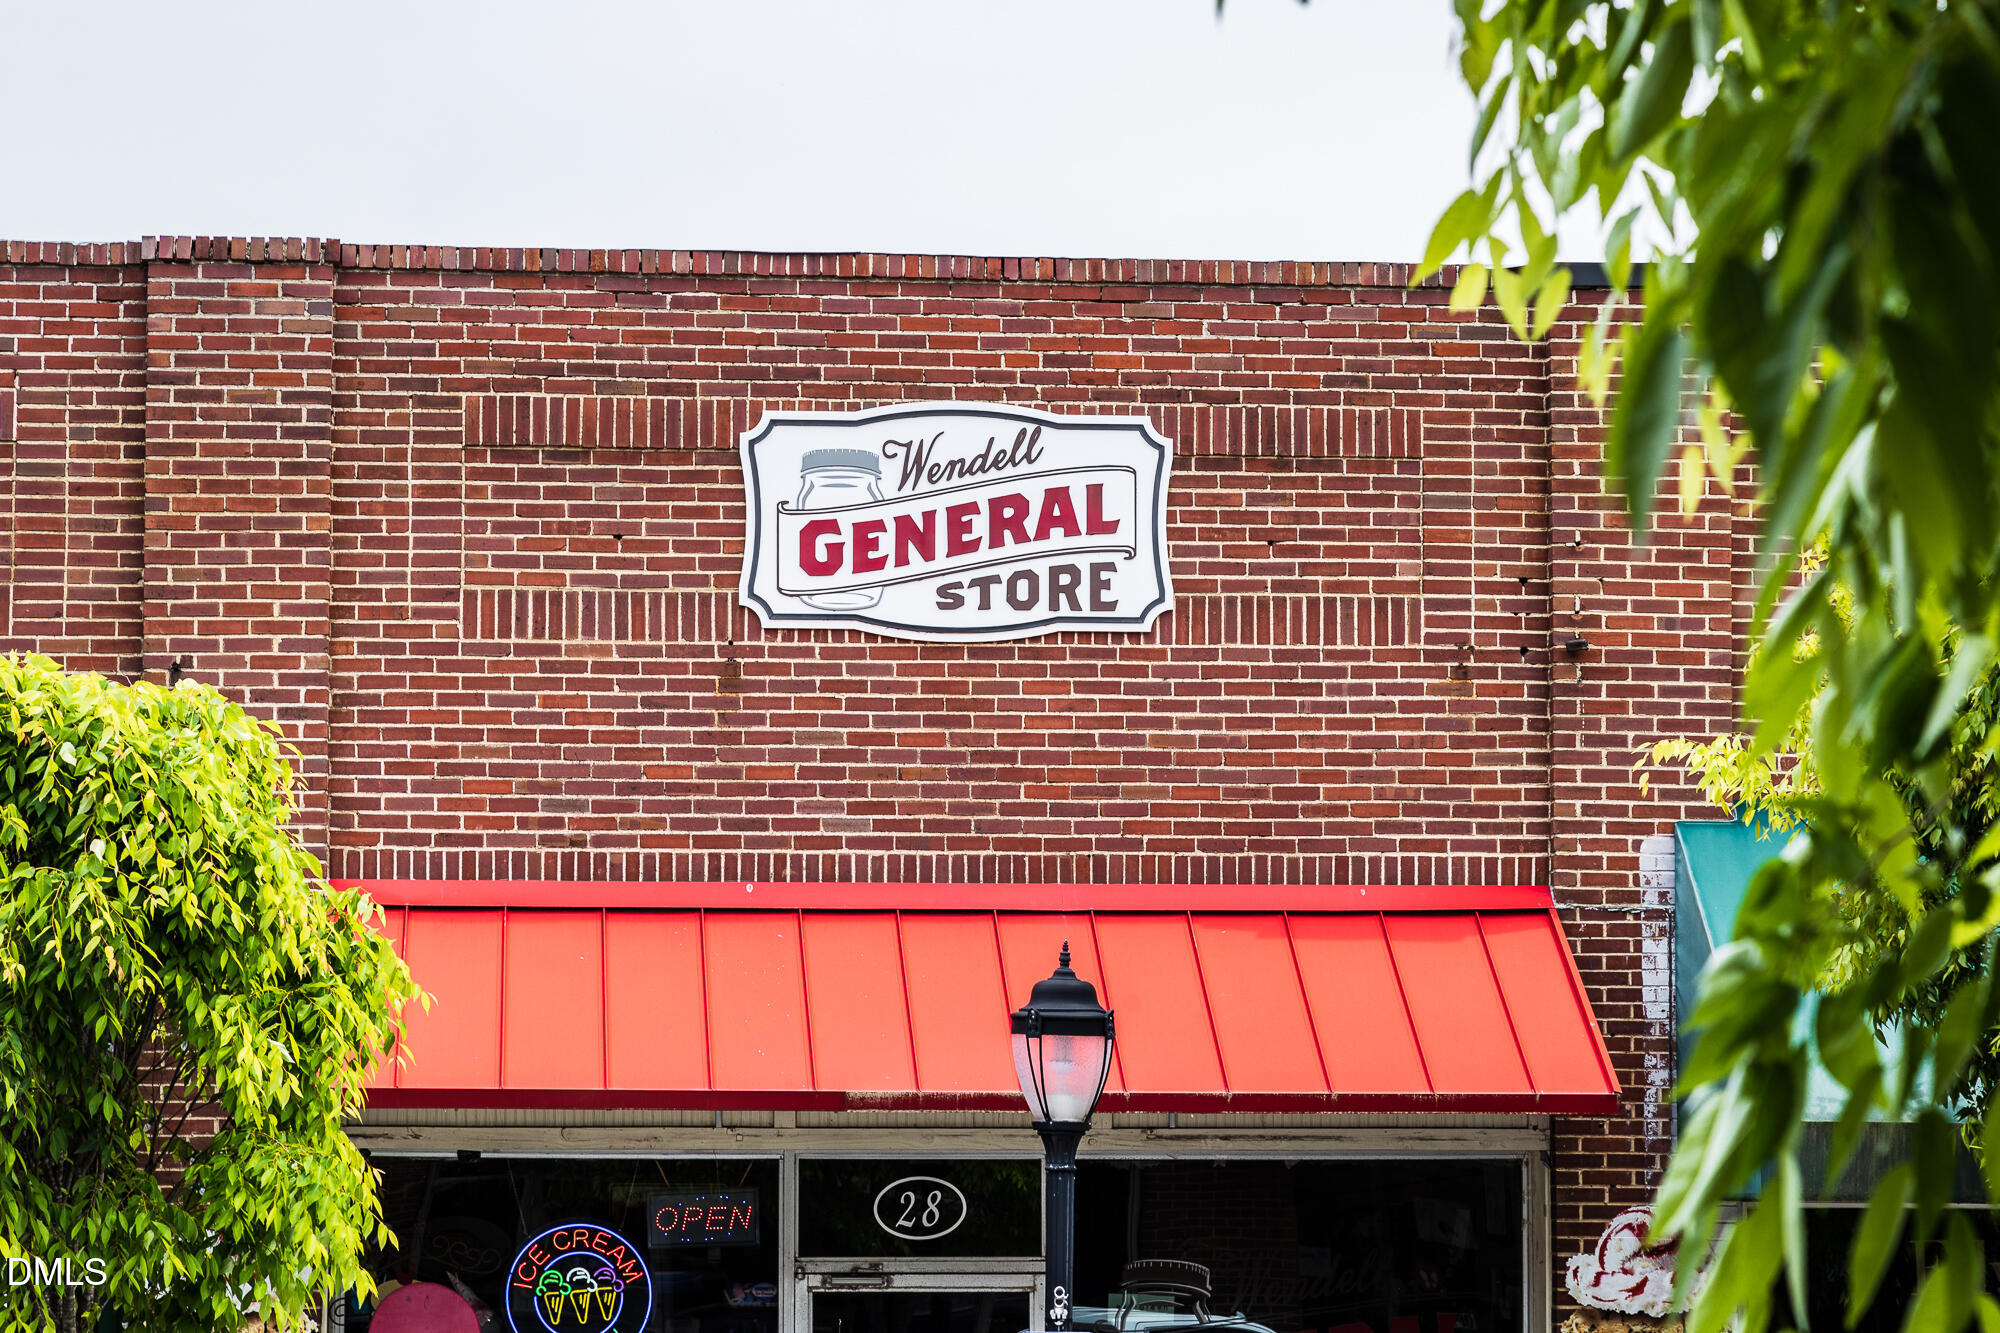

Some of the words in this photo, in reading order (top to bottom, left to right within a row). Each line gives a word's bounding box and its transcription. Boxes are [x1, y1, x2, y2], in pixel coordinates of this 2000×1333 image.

[882, 426, 1044, 492] Wendell
[799, 483, 1120, 577] GENERAL
[935, 561, 1119, 612] STORE
[655, 1205, 752, 1231] OPEN
[896, 1189, 942, 1228] 28
[513, 1243, 551, 1289] ICE
[553, 1229, 644, 1284] CREAM
